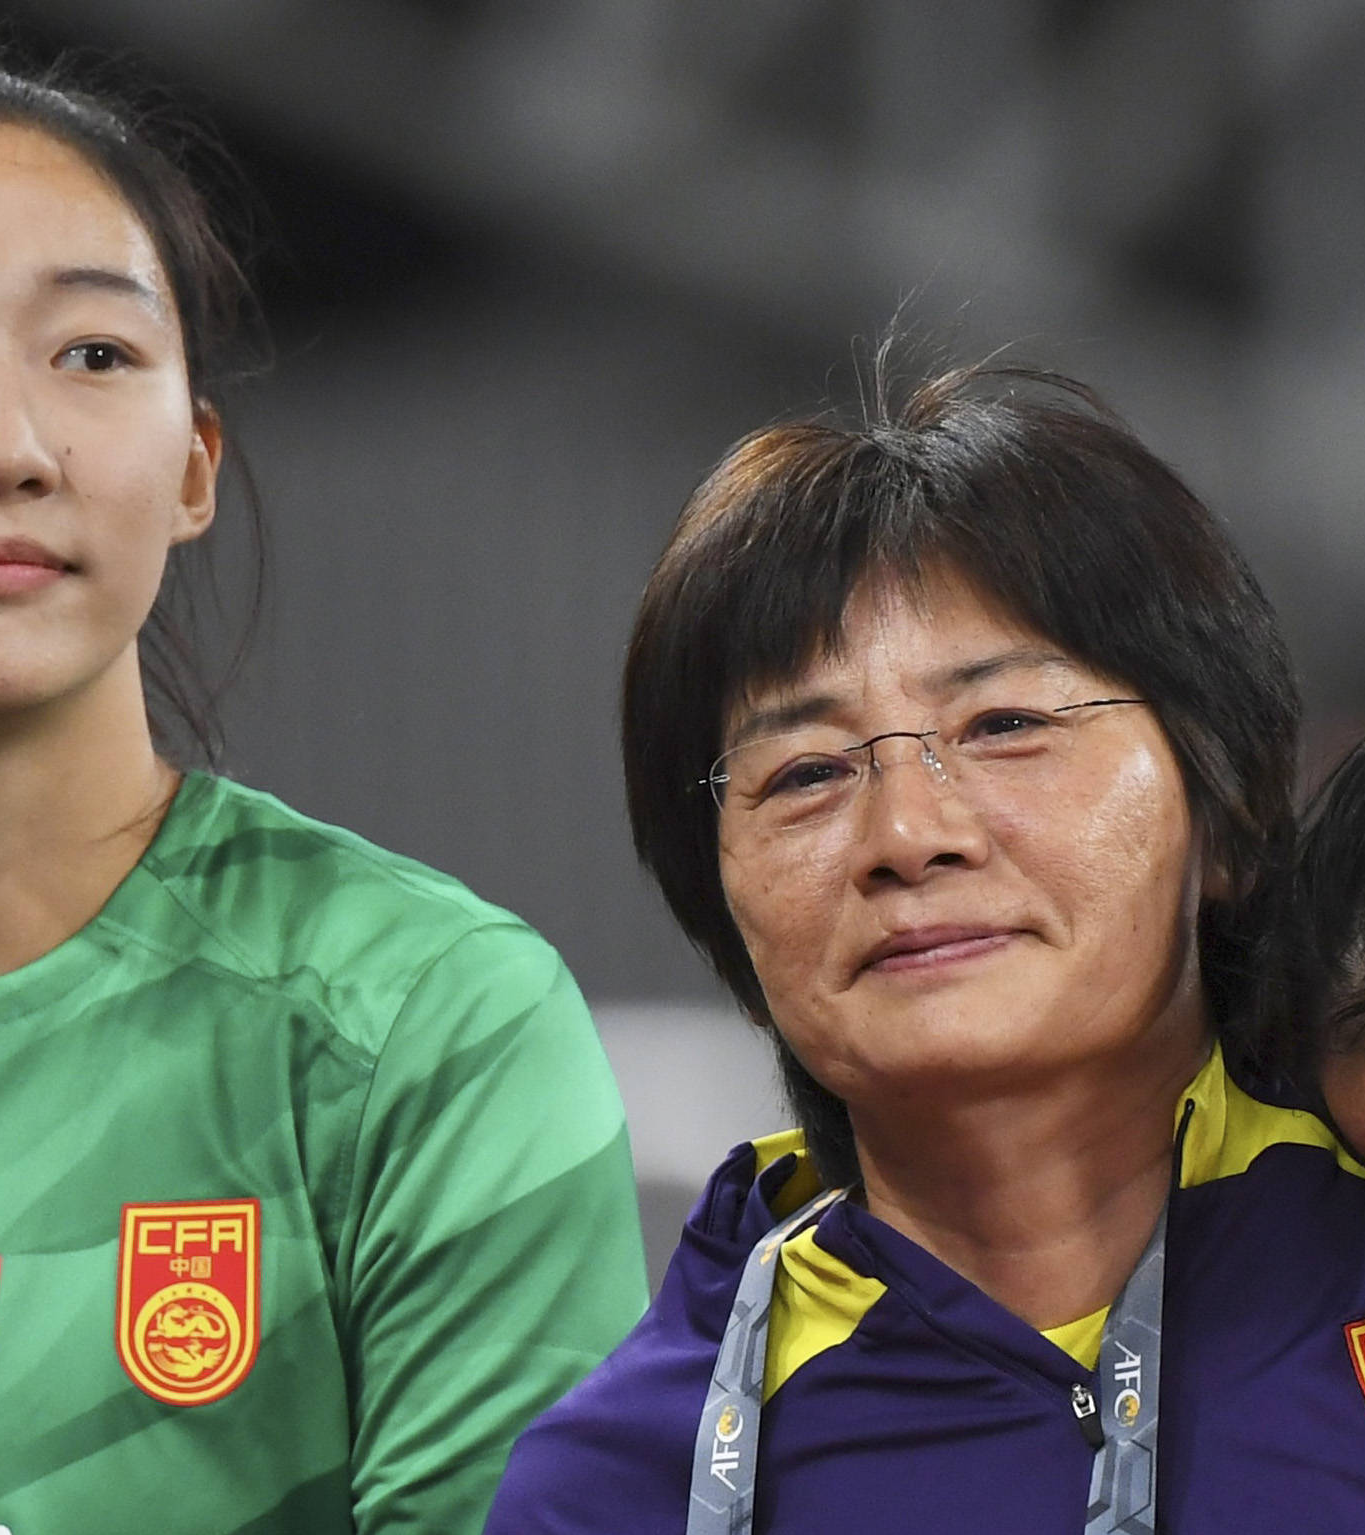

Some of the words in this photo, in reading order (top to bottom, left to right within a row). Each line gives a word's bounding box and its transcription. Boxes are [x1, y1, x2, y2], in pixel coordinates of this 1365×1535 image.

[137, 1218, 243, 1255] CFA
[169, 1254, 212, 1279] 中国
[1115, 1340, 1142, 1427] AFC
[710, 1404, 744, 1492] AFC
